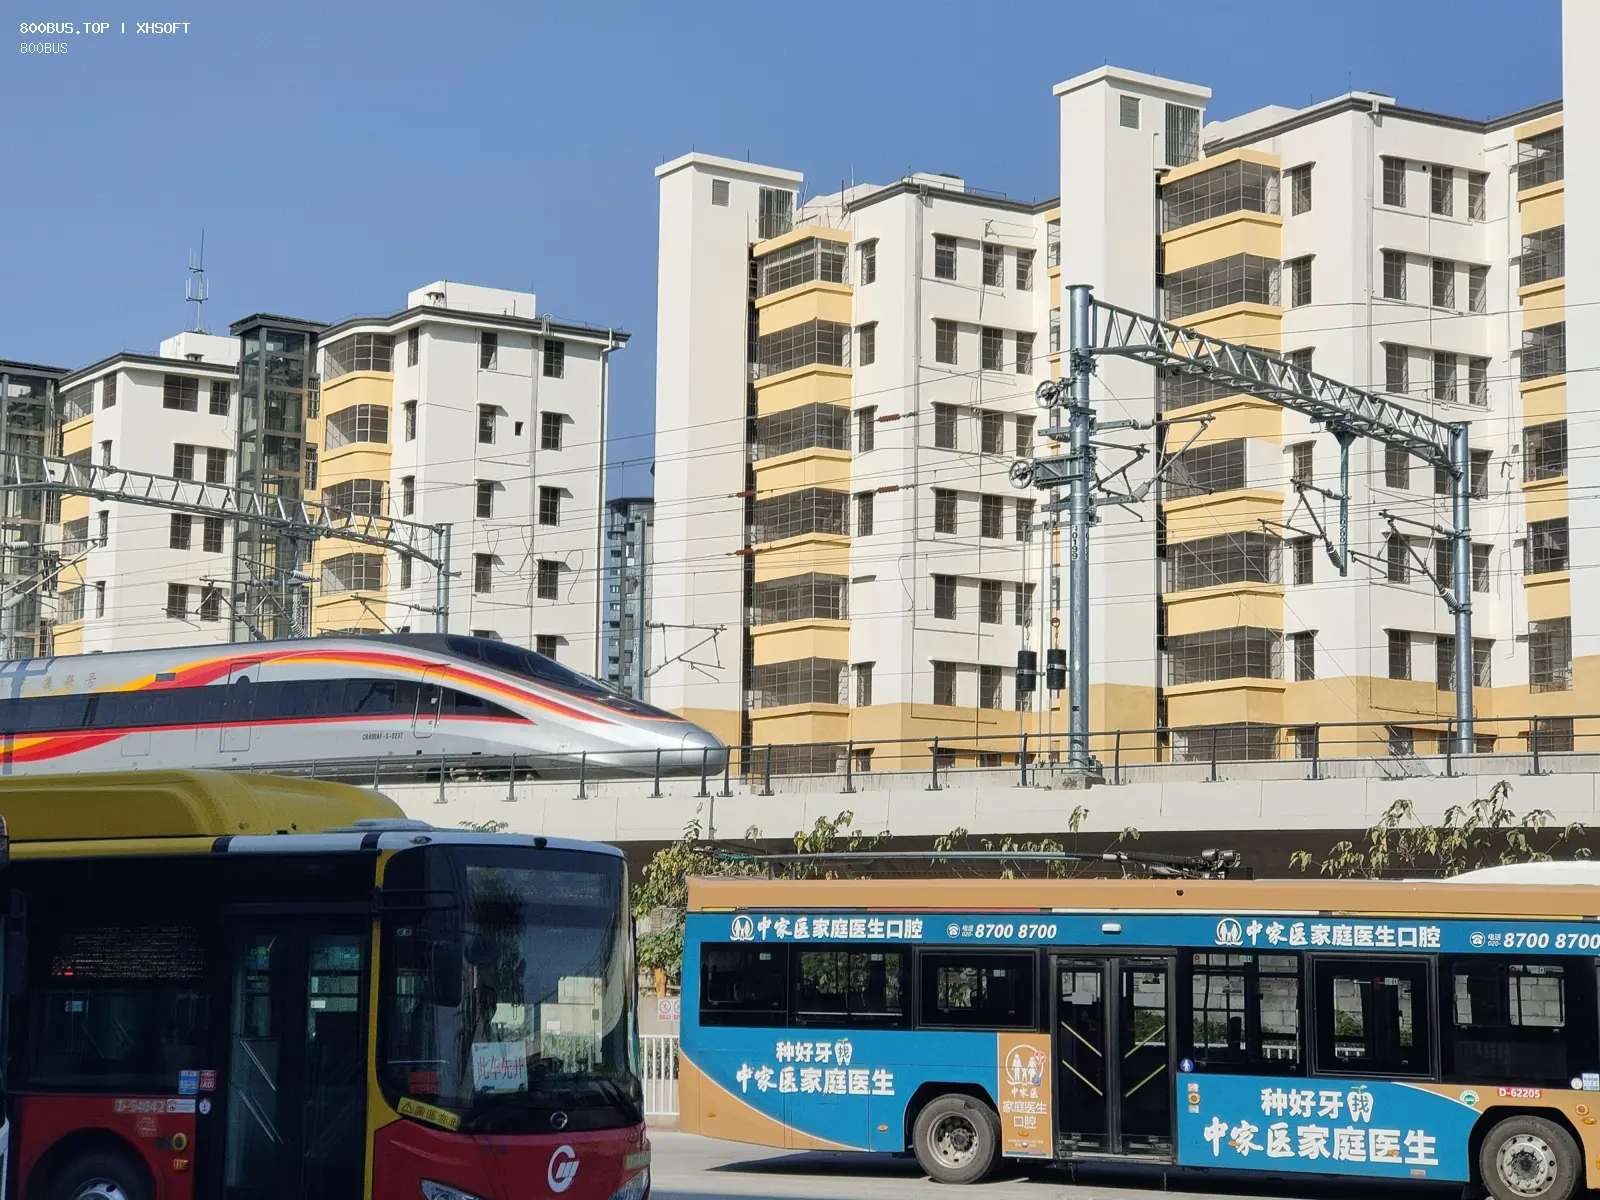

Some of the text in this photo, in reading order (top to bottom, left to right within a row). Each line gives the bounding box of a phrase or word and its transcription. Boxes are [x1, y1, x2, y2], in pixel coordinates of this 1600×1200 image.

[975, 923, 1058, 939] 8700 8700
[1503, 932, 1600, 949] 8700 8700
[736, 1063, 895, 1096] 中家医家庭医生
[1010, 1086, 1039, 1099] 中家医
[1499, 1088, 1541, 1099] D-62205
[1002, 1100, 1048, 1114] 家庭医生
[1013, 1116, 1037, 1130] 口腔
[1203, 1116, 1439, 1166] 中家医家庭医生
